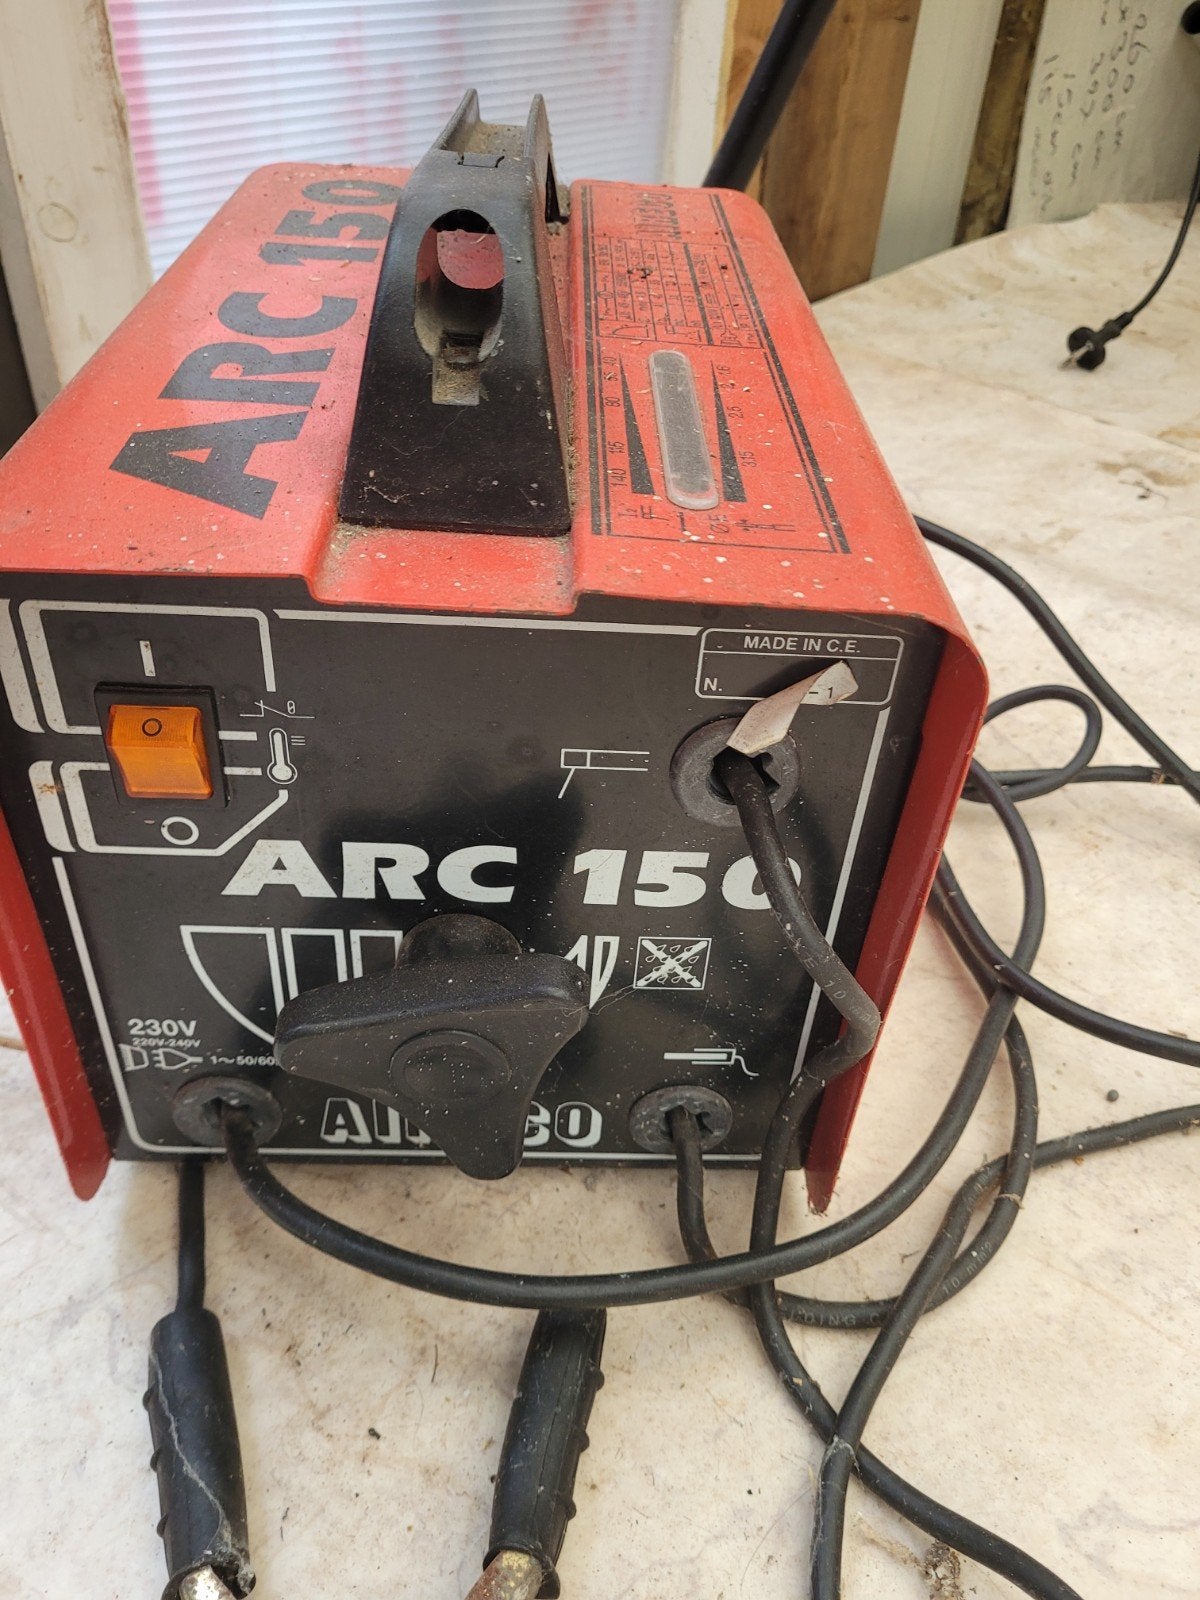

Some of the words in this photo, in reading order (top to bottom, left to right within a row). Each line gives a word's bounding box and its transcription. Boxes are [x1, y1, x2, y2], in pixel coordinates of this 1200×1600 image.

[109, 291, 358, 520] ARC
[258, 179, 405, 267] 150
[605, 396, 621, 408] 80
[611, 468, 628, 487] 140
[743, 635, 798, 650] MADE
[803, 638, 822, 652] IN
[826, 639, 861, 653] C.E.
[703, 677, 723, 692] N.
[221, 839, 518, 903] ARC
[573, 849, 803, 911] 150
[127, 1018, 197, 1037] 230V
